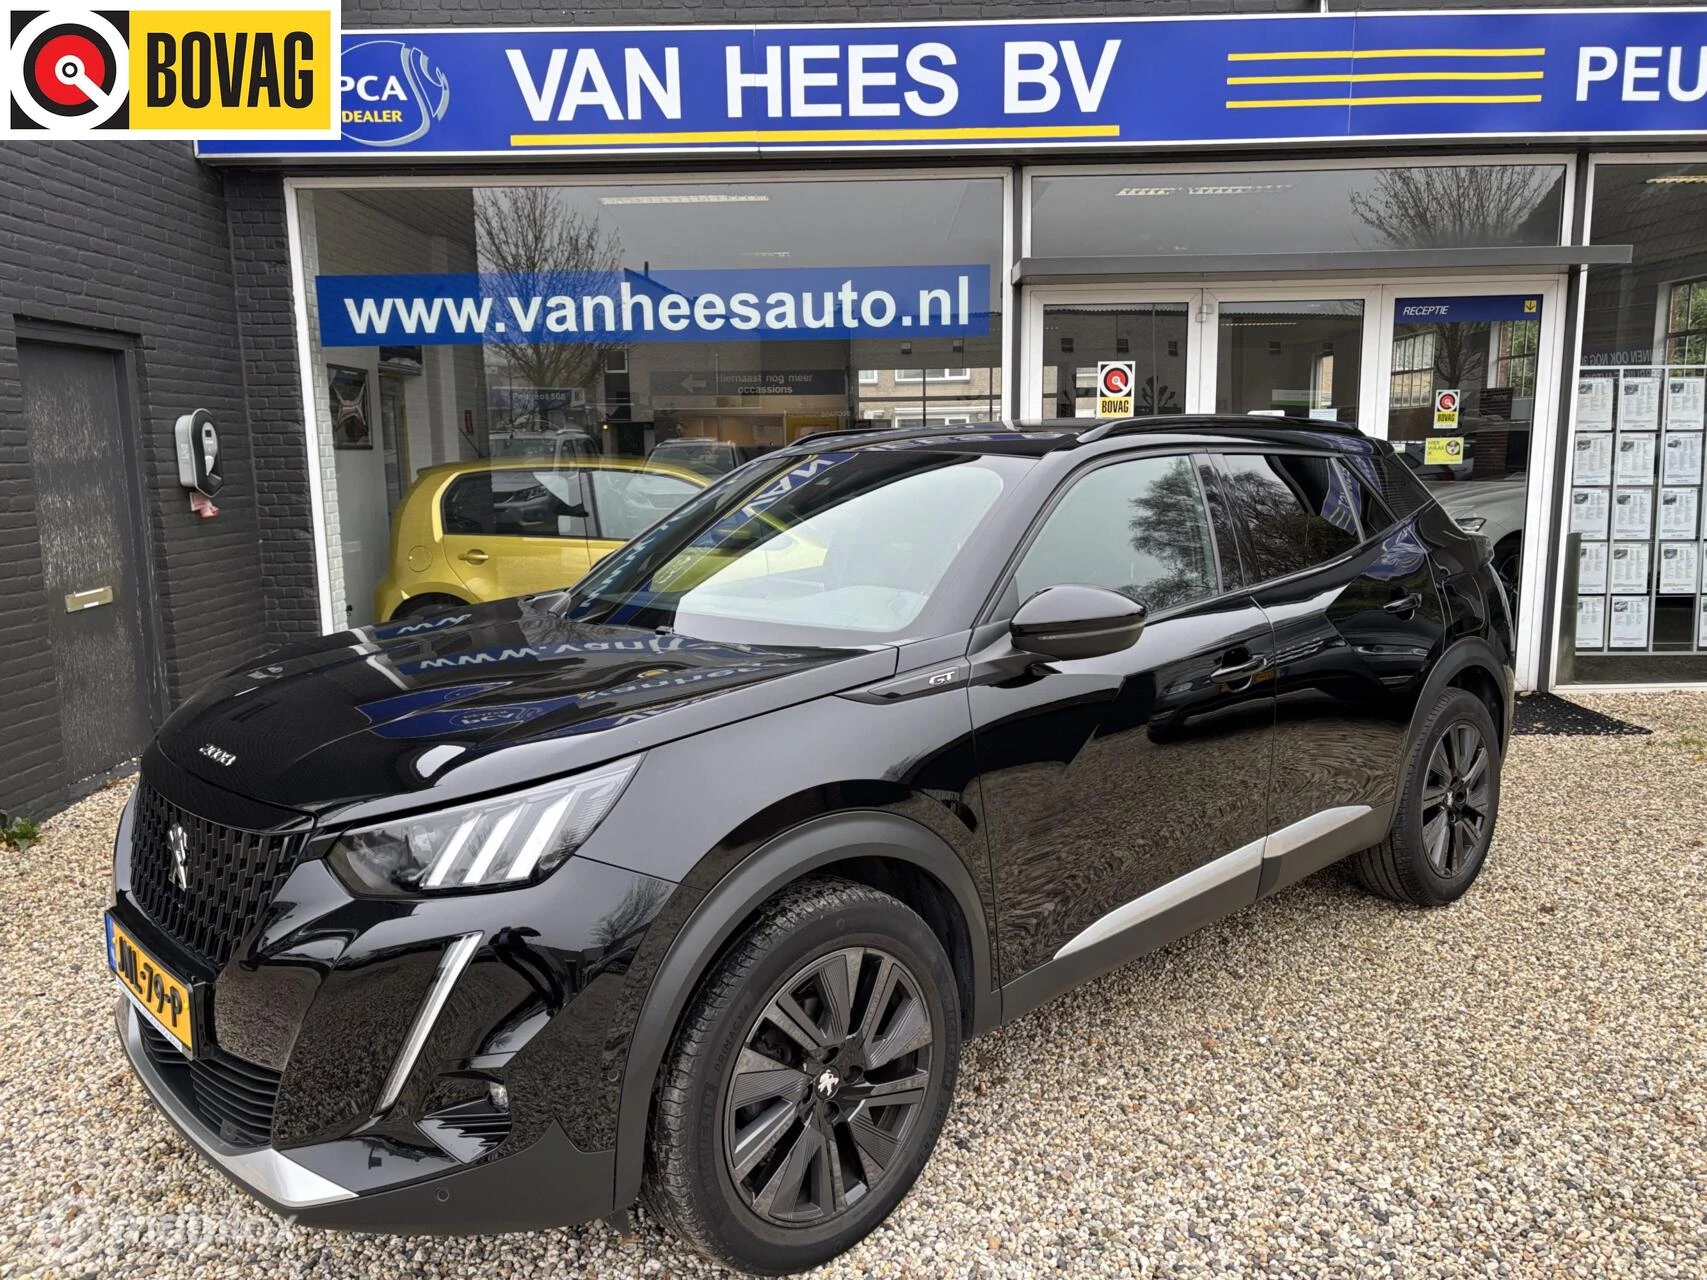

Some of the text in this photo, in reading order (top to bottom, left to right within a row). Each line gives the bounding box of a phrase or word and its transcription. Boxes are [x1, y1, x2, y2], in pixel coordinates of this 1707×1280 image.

[507, 39, 1122, 122] VAN HEES BV
[1576, 45, 1707, 102] PEU
[341, 110, 403, 123] DEALER
[344, 275, 969, 335] www.vanheesauto.nl
[1403, 305, 1449, 316] RECEPTIE
[738, 385, 792, 394] occassions
[1101, 400, 1129, 413] BOVAG
[928, 671, 955, 686] GT
